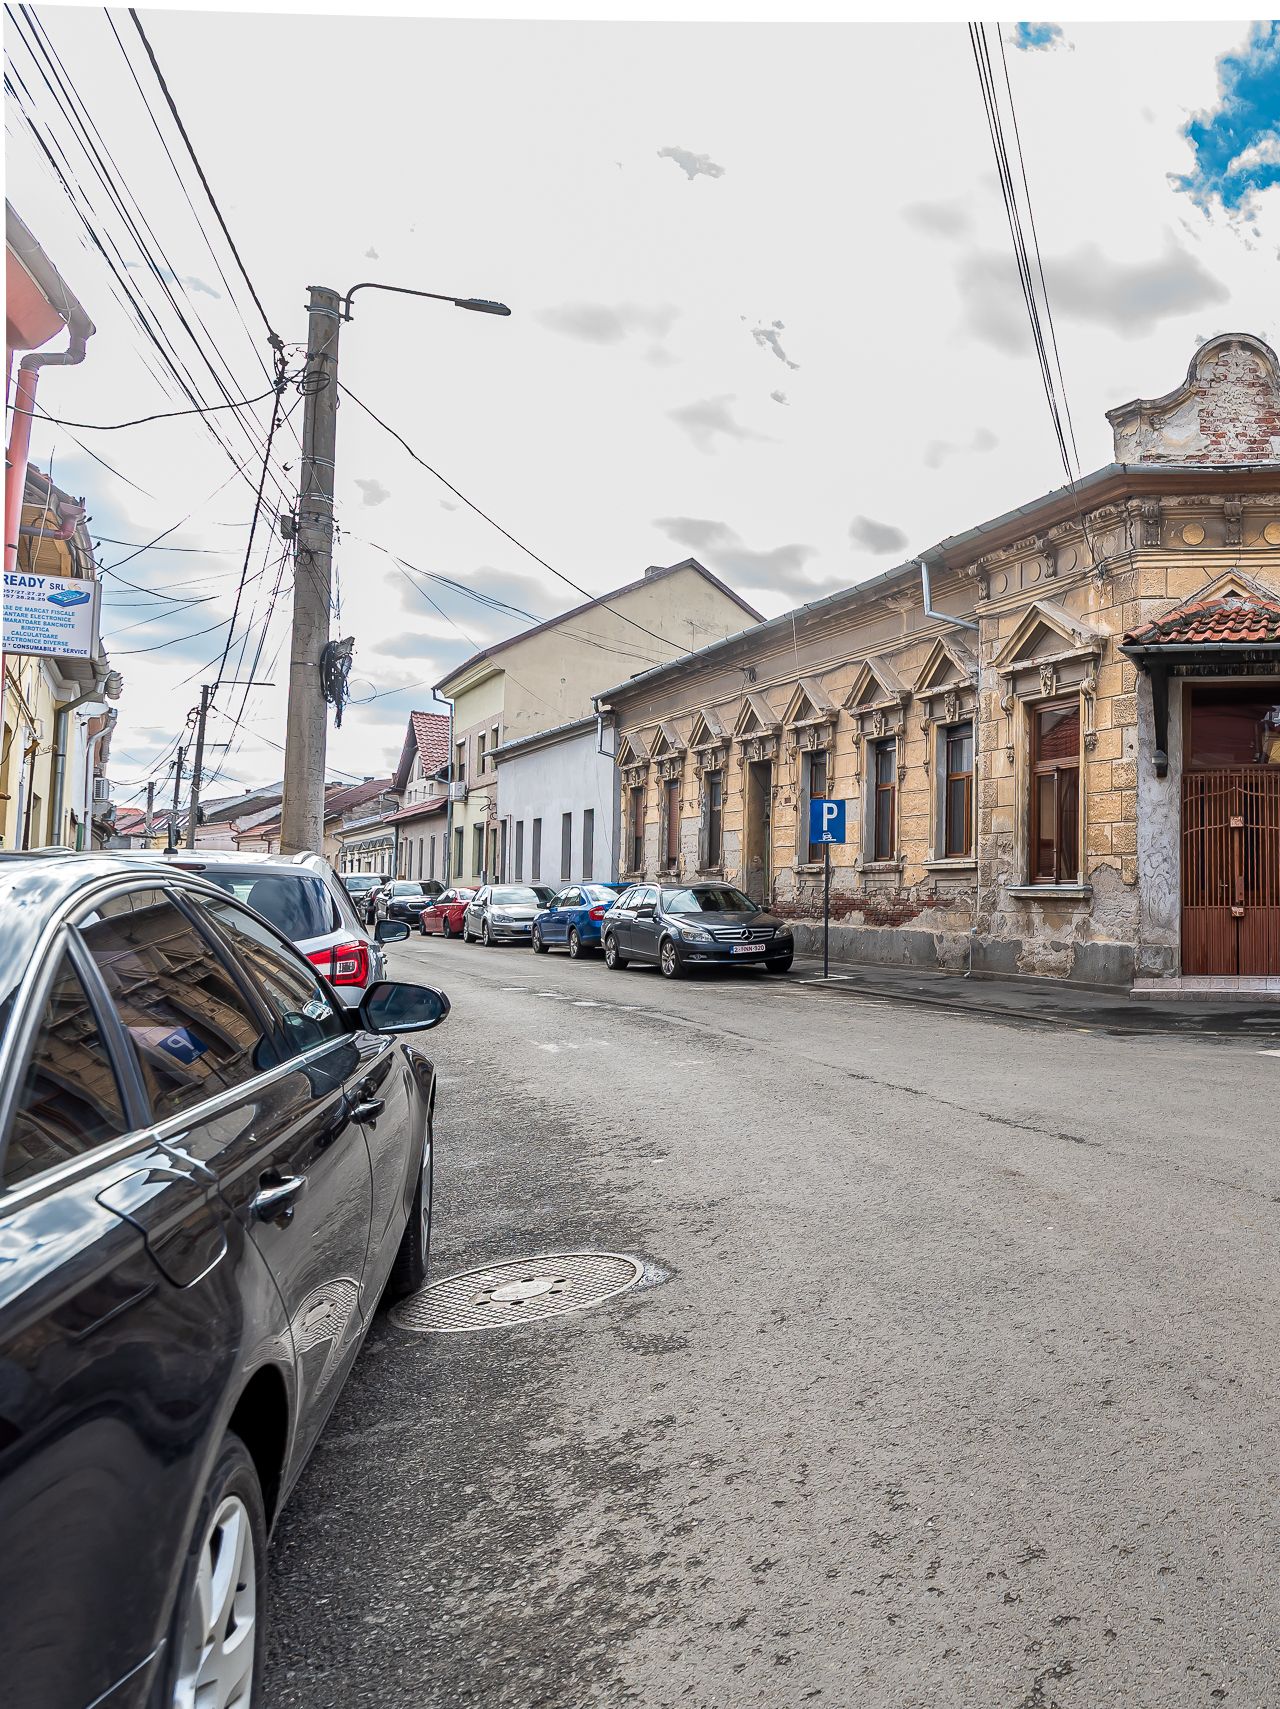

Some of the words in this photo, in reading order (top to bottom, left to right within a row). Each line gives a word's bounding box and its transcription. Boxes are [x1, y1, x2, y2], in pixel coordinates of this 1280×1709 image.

[50, 582, 66, 590] SRL
[30, 614, 71, 622] ELECTRONICE
[21, 625, 50, 633] BIROTICA
[11, 630, 59, 639] CALCULATOARE
[43, 639, 69, 647] DIVERSE
[13, 643, 57, 652] CONSUMABILE
[823, 802, 838, 831] P
